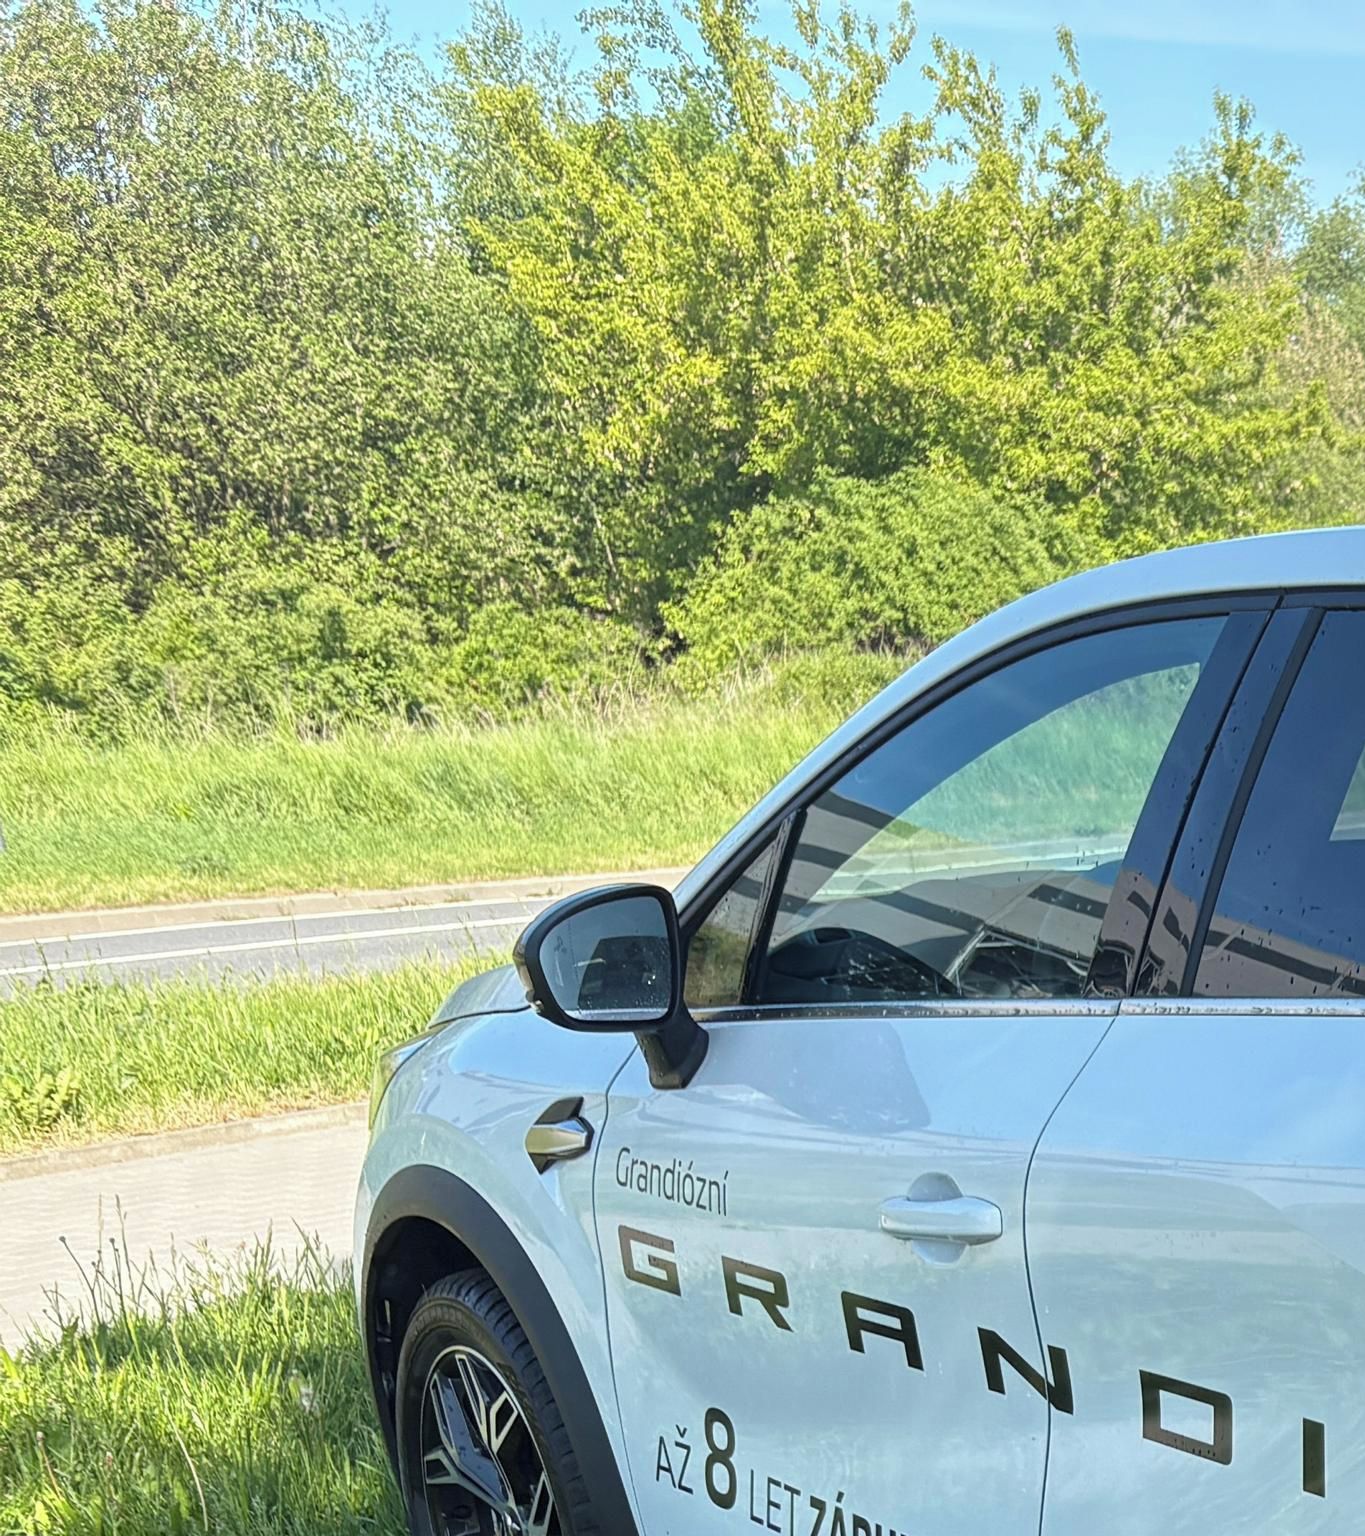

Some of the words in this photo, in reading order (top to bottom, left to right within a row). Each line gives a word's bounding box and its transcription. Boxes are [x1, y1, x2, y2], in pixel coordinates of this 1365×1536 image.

[615, 1146, 730, 1217] Grandiózní
[655, 1424, 694, 1496] AŽ
[703, 1407, 738, 1510] 8
